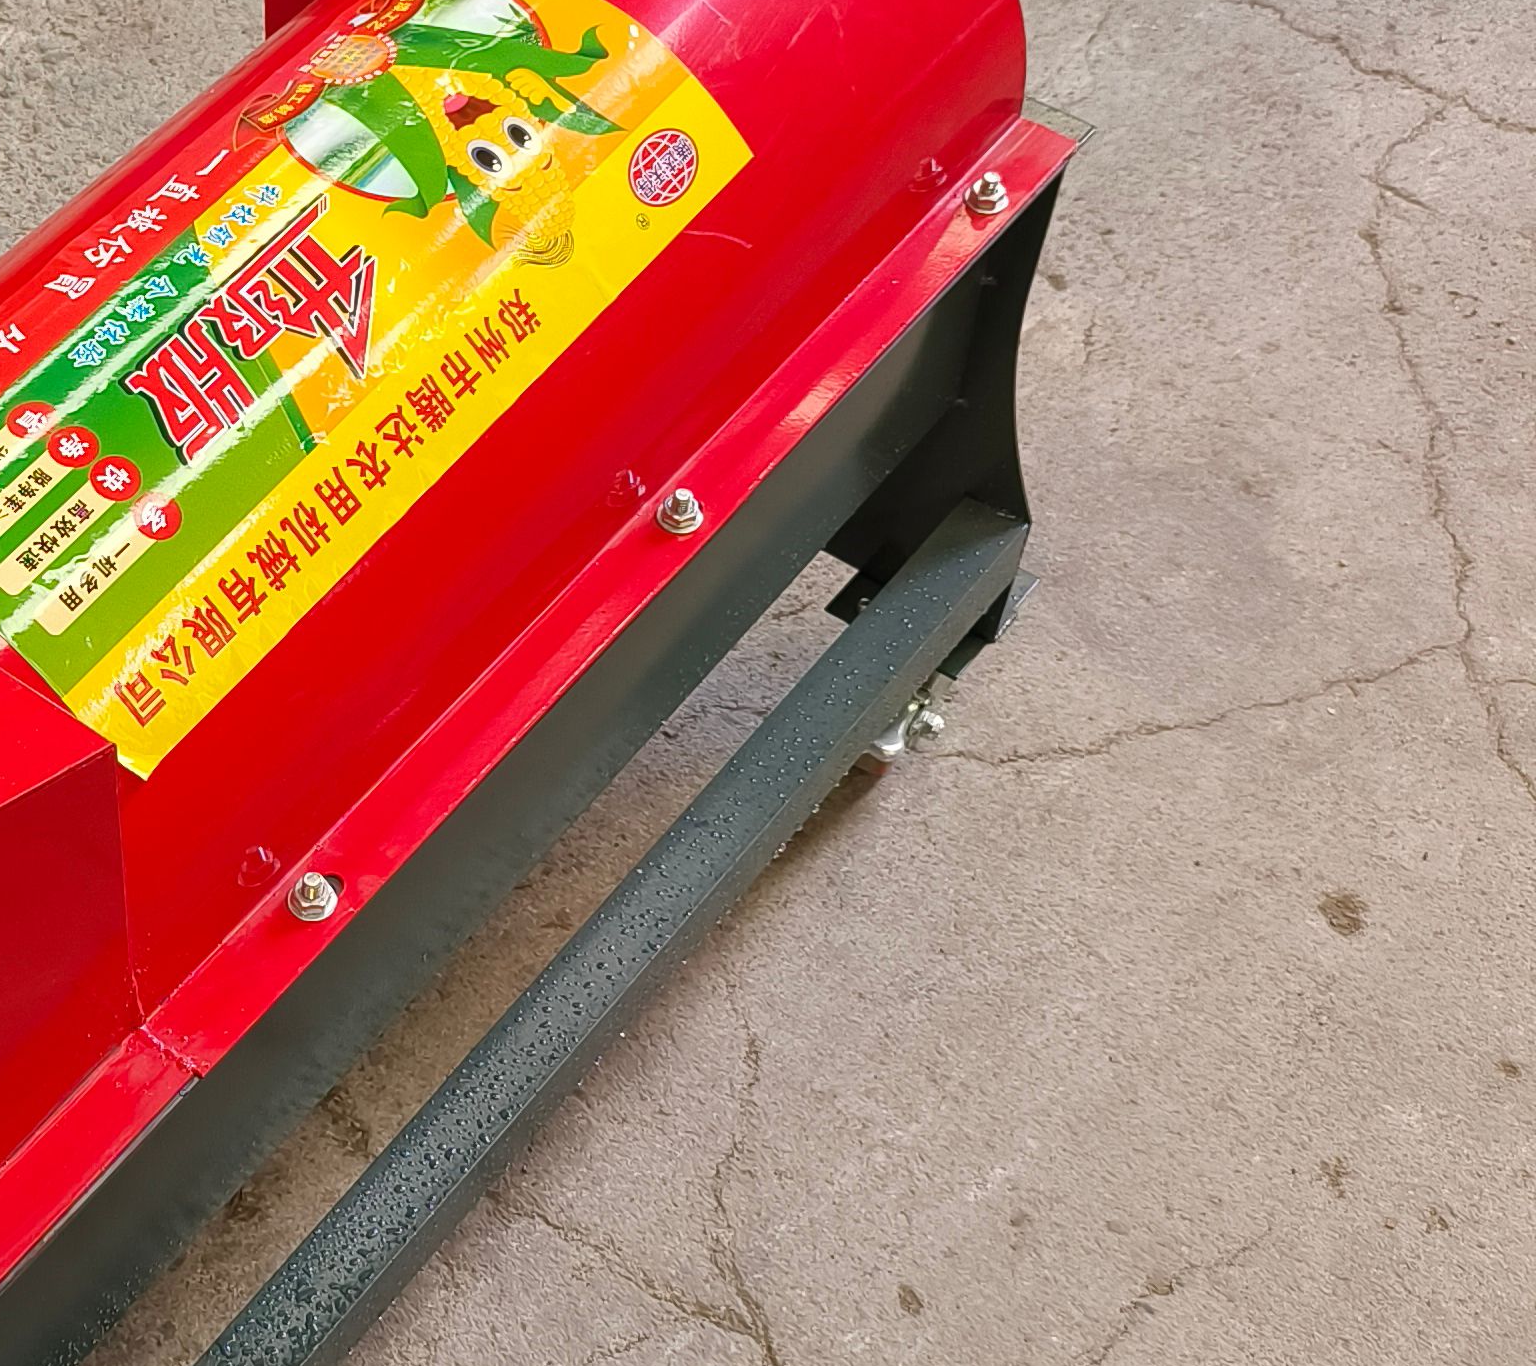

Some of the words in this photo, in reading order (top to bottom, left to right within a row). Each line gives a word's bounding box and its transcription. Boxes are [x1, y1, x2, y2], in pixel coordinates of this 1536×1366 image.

[637, 137, 693, 198] 腾达沃得
[43, 148, 230, 299] 一直被仿冒
[172, 182, 283, 267] 科技领先
[67, 274, 179, 368] 全新体验
[119, 193, 377, 467] 升级版
[15, 410, 49, 434] 省
[58, 433, 90, 459] 净
[96, 464, 131, 492] 快
[113, 288, 544, 728] 郑州市腾达农用机械有限公司
[16, 498, 96, 573] 高效快速
[141, 502, 167, 533] 多
[58, 542, 131, 612] 一机多用
